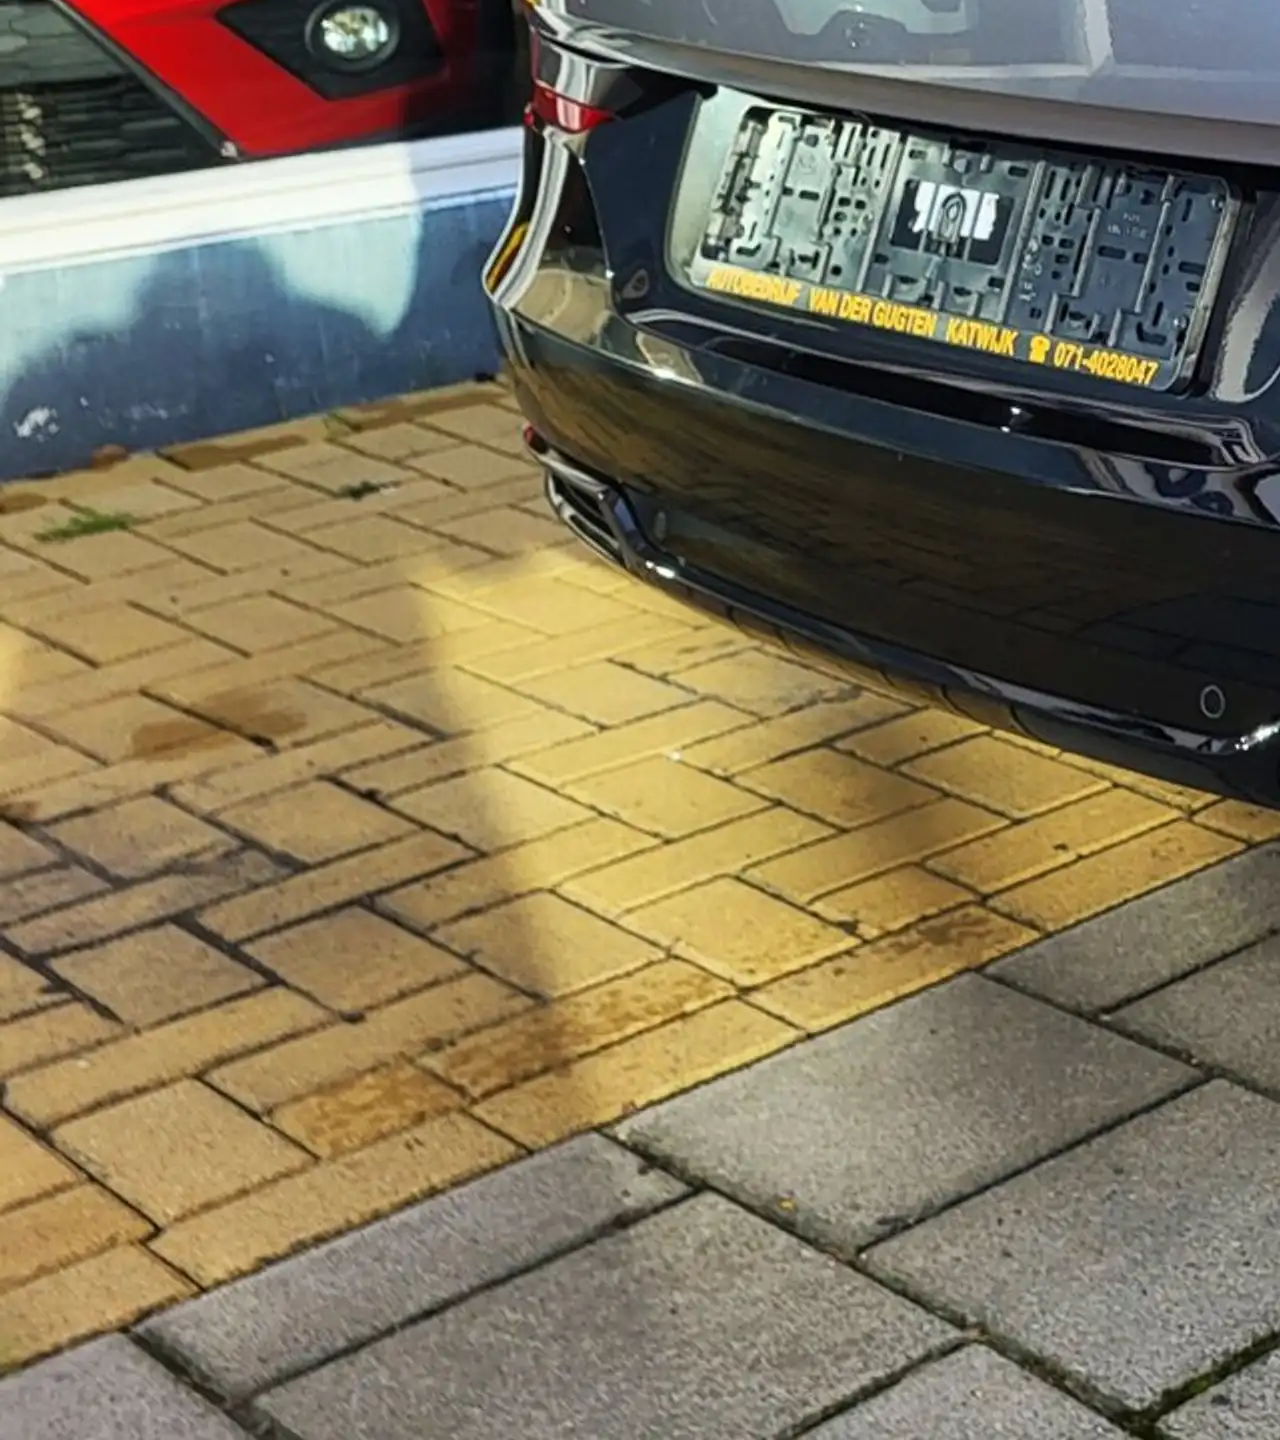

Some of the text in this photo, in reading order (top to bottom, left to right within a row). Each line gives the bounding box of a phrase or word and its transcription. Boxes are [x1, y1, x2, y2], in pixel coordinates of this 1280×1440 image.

[707, 268, 1159, 387] AUTOBEDRIJF VAN DER GUGTEN KATWIJK 071-4028047
